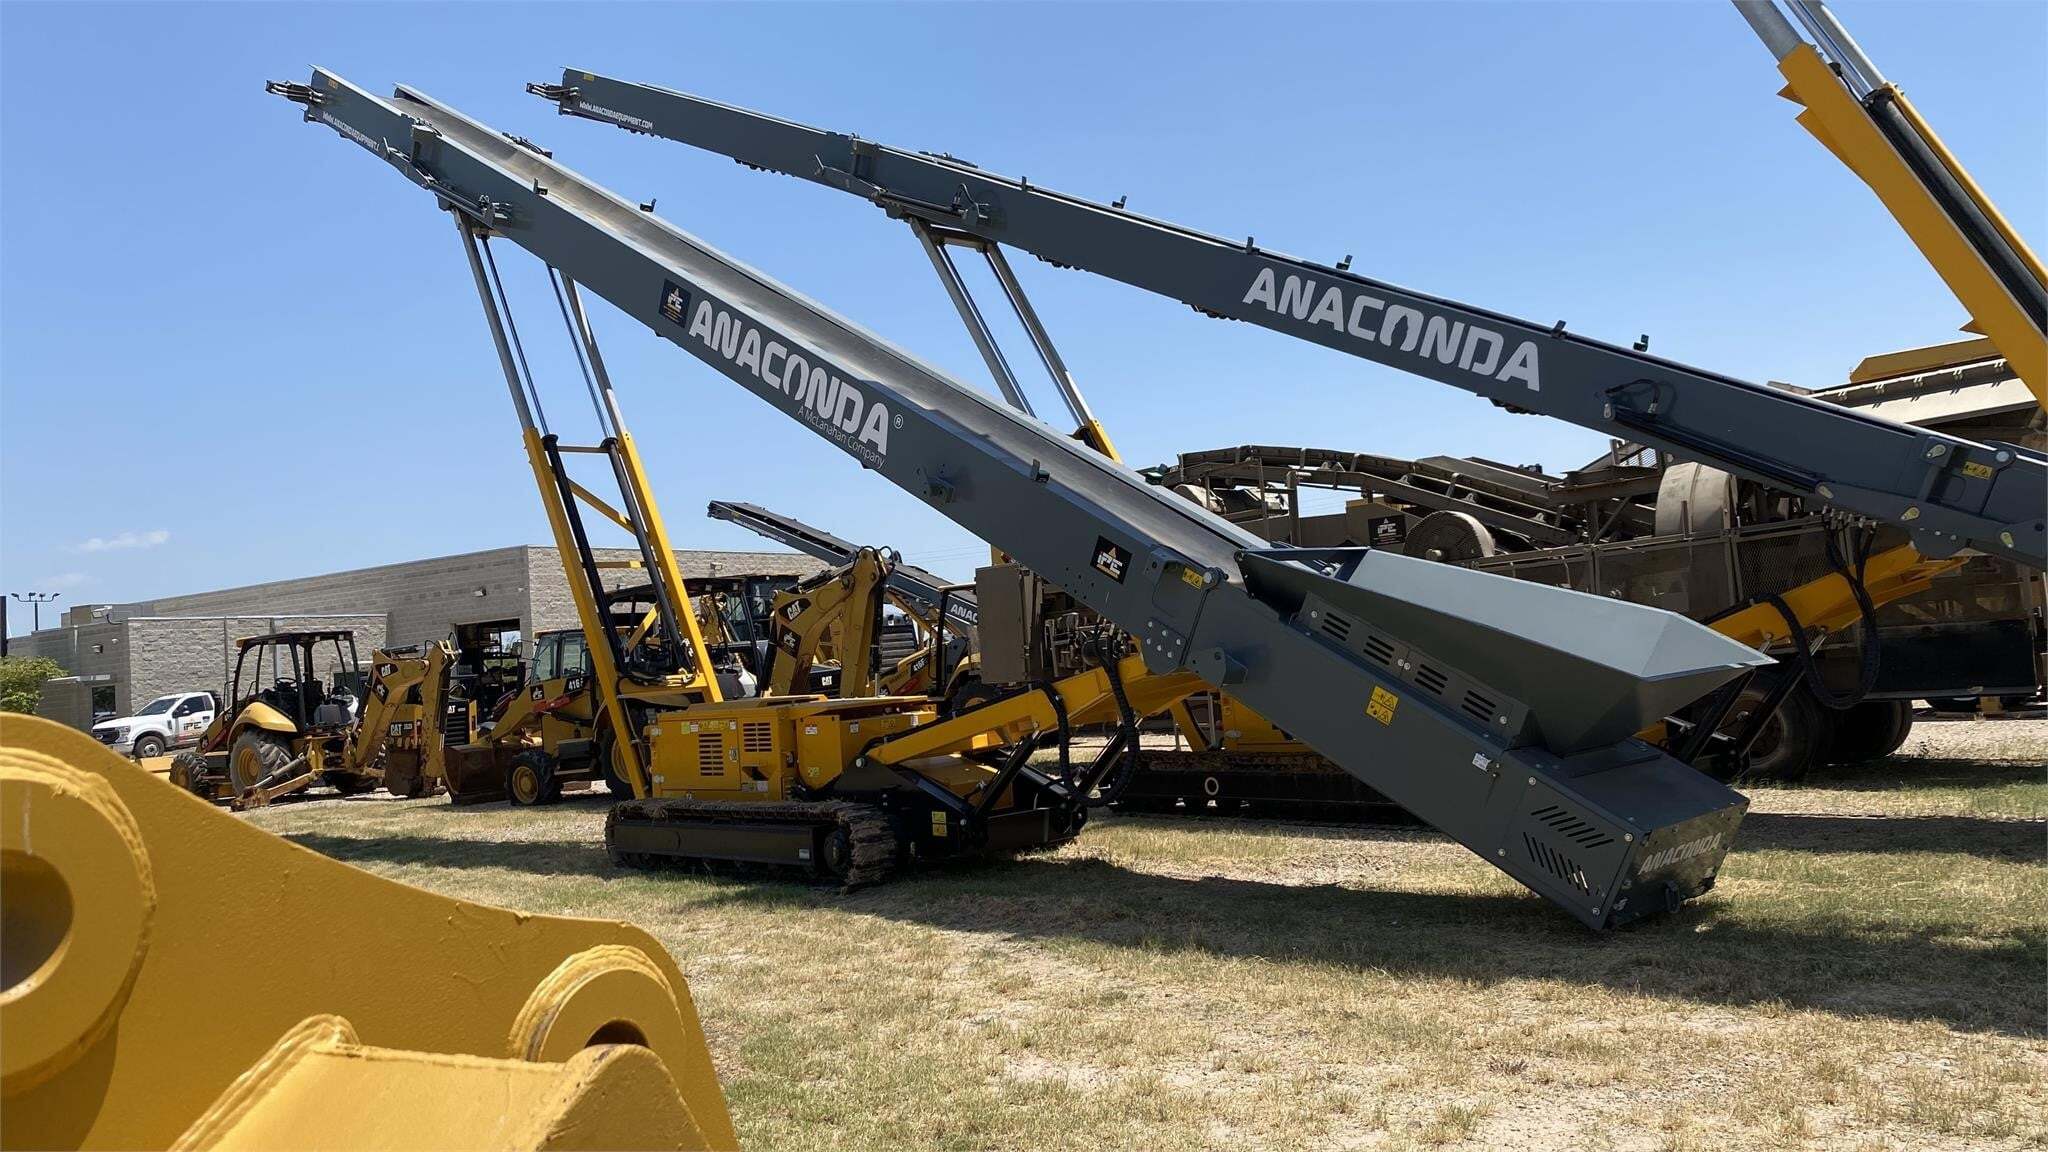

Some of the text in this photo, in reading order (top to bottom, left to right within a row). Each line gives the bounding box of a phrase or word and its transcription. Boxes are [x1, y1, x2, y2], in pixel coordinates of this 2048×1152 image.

[579, 101, 653, 130] WWW.ANACONDAEQUIPMENT.COM
[1242, 267, 1540, 392] ANACONDA
[688, 300, 888, 456] ANACONDA
[804, 410, 847, 445] McLanahan
[847, 436, 885, 469] Company
[787, 600, 801, 620] CAT
[381, 664, 391, 677] CAT
[821, 676, 833, 686] CAT
[390, 723, 402, 736] CAT
[1637, 832, 1722, 875] ANACONDA
